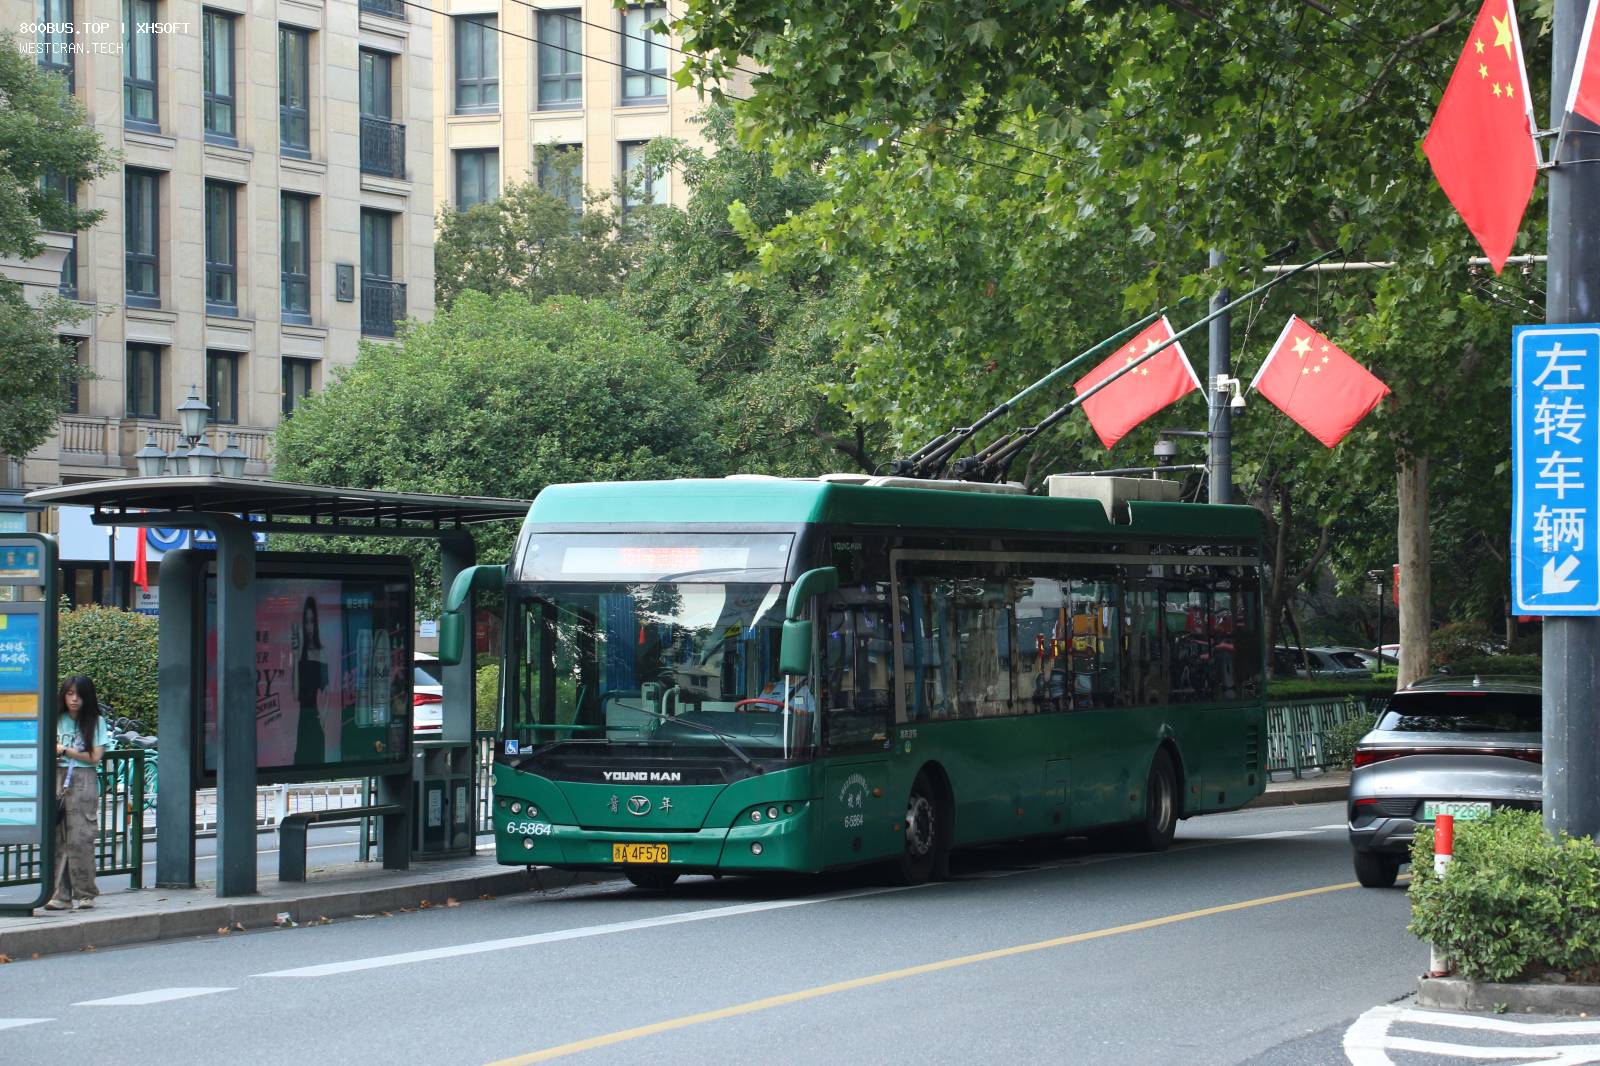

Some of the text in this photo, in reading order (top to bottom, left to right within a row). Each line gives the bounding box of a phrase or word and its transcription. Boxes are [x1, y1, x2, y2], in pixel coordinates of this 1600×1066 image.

[1532, 342, 1587, 552] 左转车辆
[603, 771, 681, 781] YOUNG MAN
[844, 814, 864, 828] 6-5864
[506, 821, 552, 836] 6-5864
